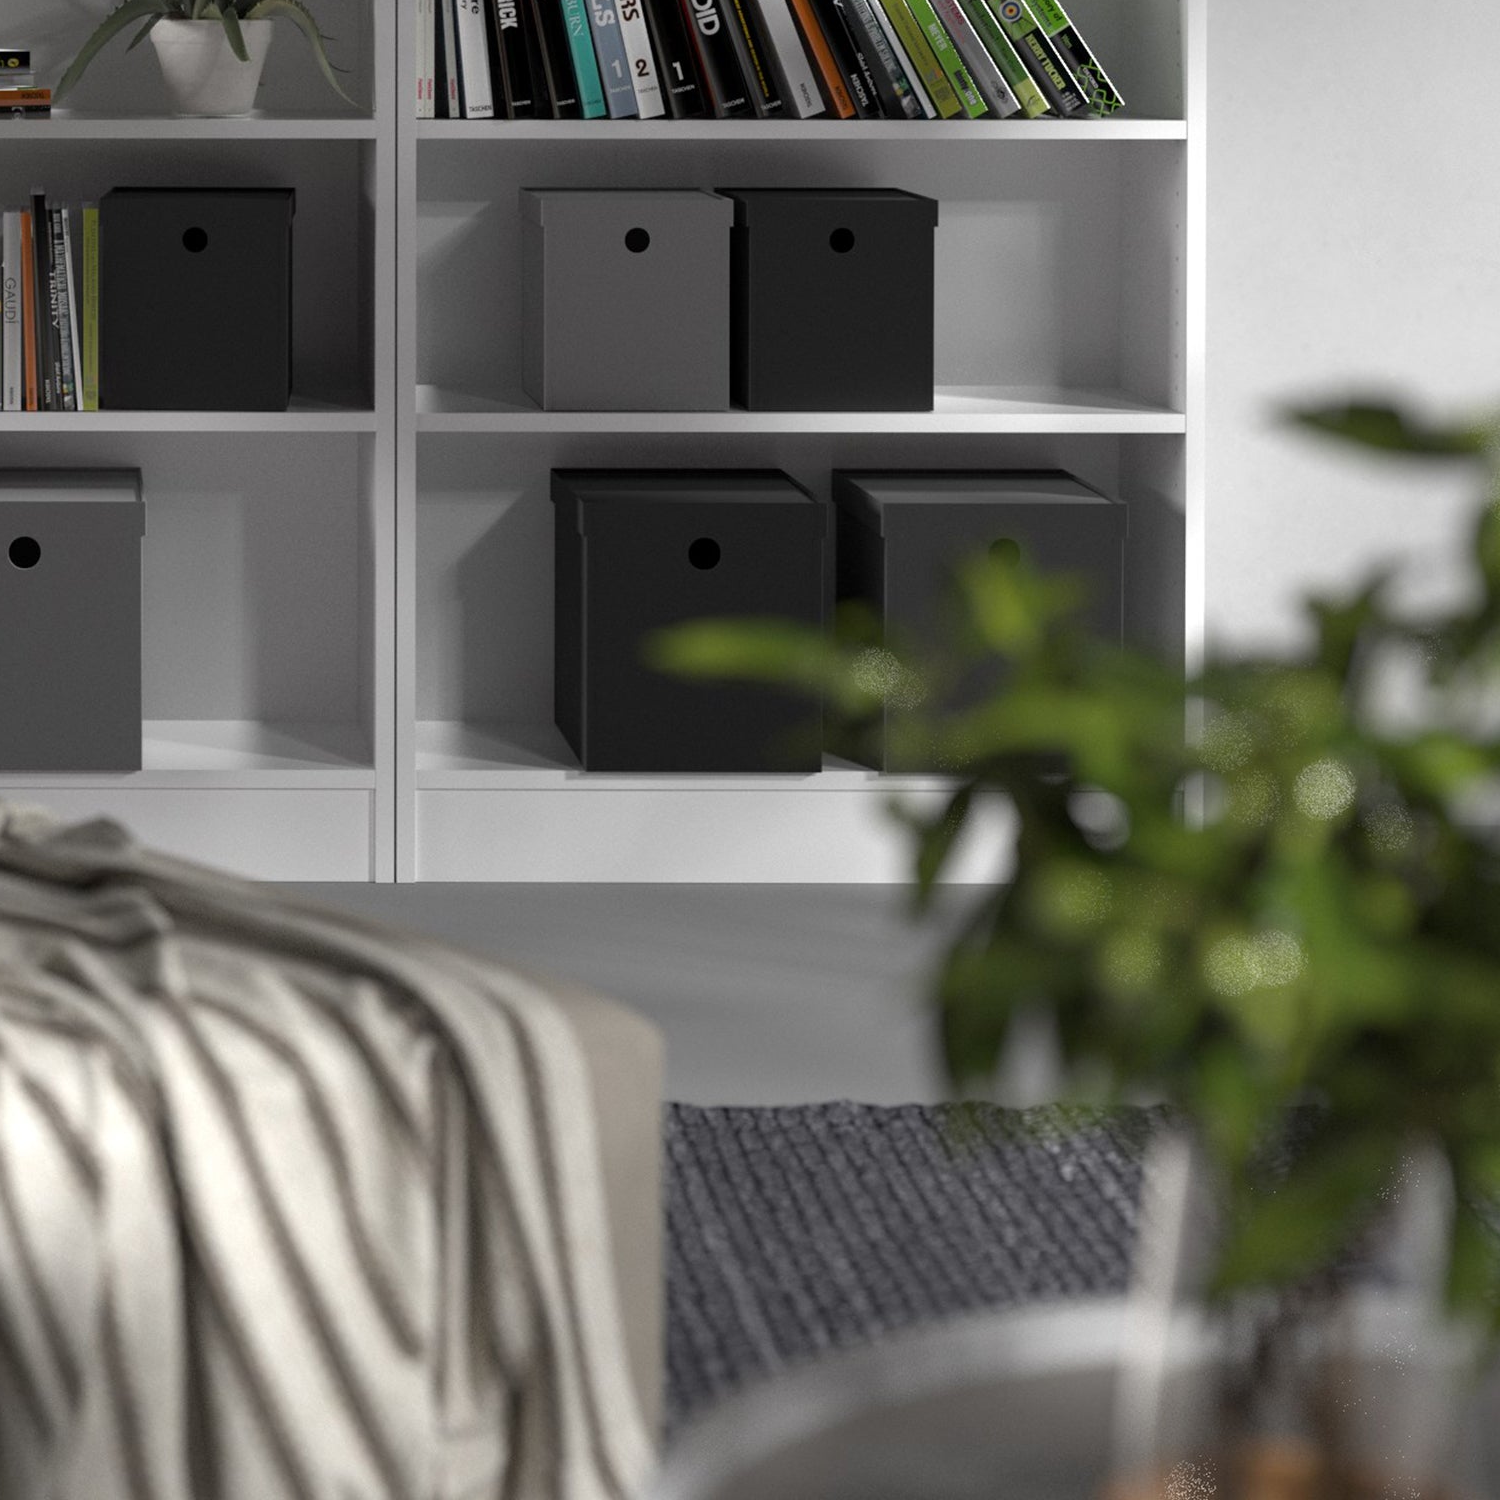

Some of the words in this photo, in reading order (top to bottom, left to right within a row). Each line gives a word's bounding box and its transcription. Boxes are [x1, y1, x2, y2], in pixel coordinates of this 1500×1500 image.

[926, 22, 949, 52] MEYER
[611, 59, 623, 79] 1
[635, 58, 650, 78] 2
[671, 61, 684, 81] 1
[1024, 33, 1048, 63] KERRY
[1040, 57, 1067, 91] TUCKER
[850, 73, 869, 107] TASCHEN
[50, 272, 60, 329] TRINITY
